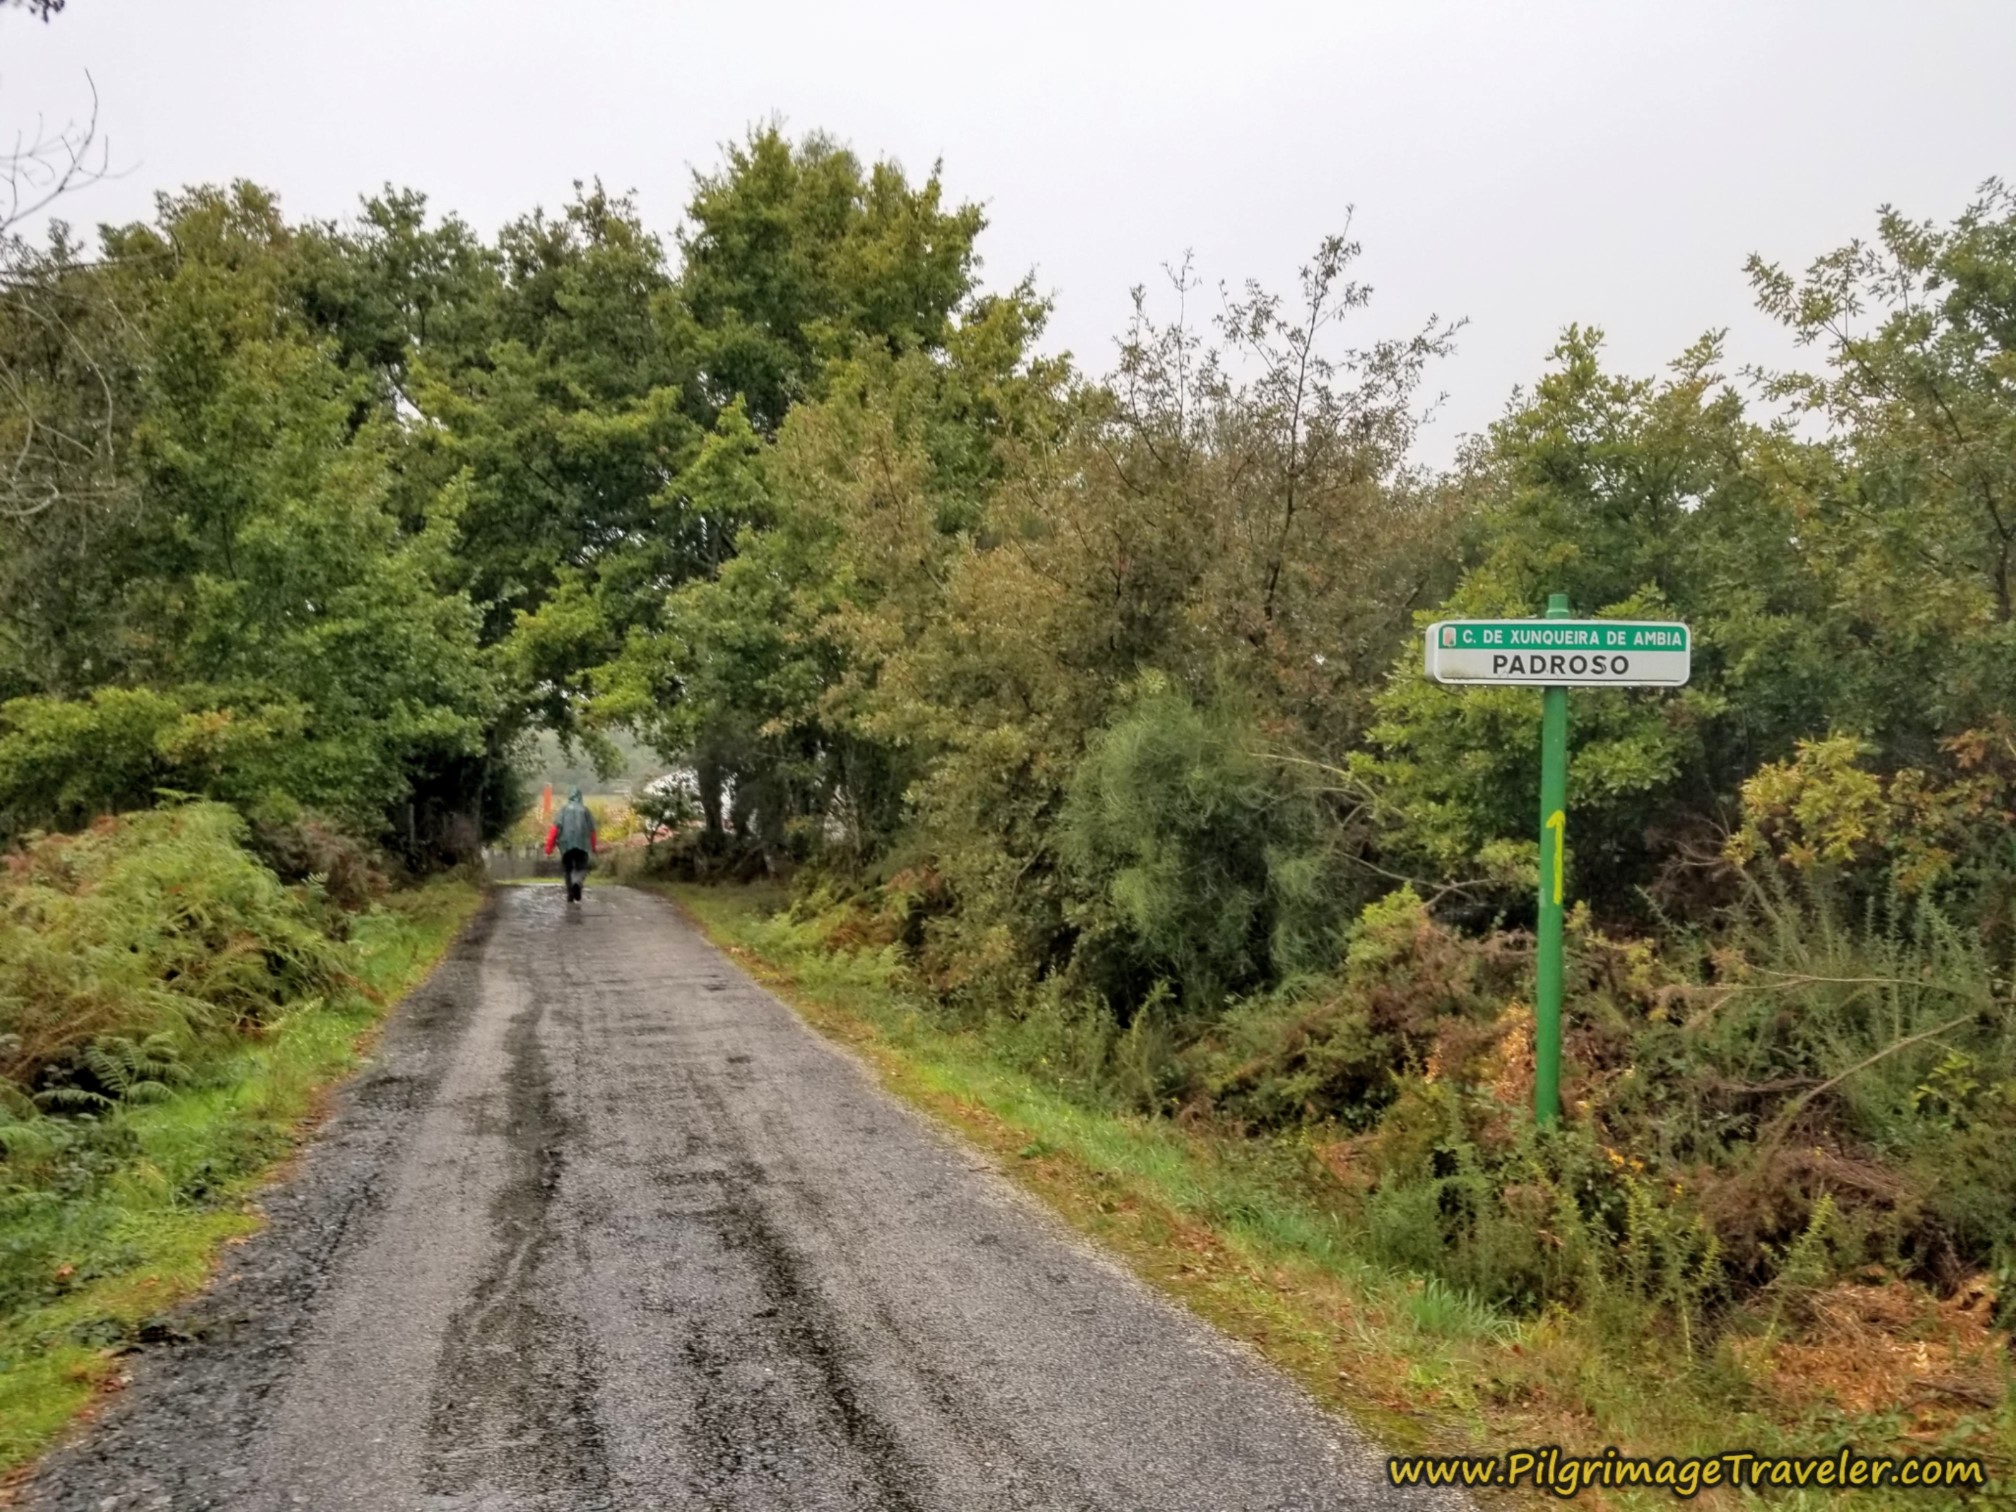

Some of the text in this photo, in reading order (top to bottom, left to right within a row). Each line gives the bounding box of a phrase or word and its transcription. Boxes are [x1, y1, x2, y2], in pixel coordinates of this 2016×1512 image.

[1462, 629, 1682, 646] C. DE XUNQUEIRA DE AMBIA
[1493, 655, 1629, 675] PADROSO
